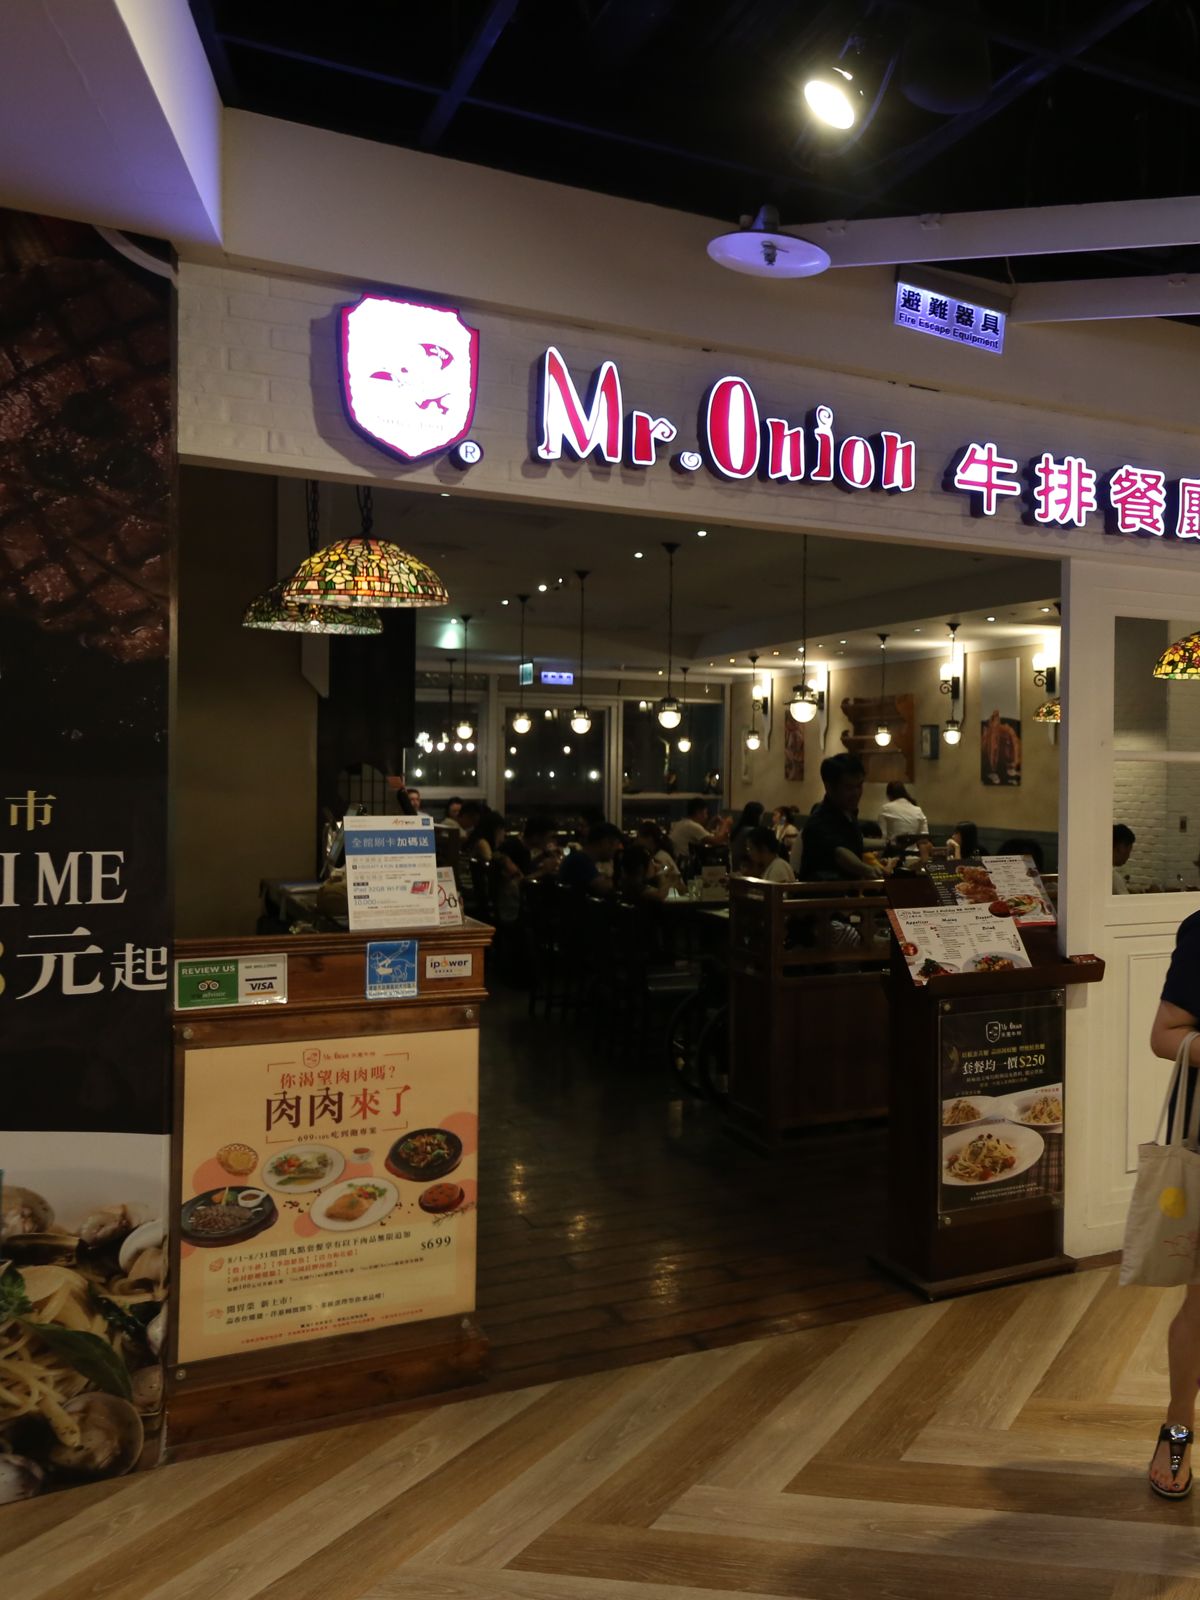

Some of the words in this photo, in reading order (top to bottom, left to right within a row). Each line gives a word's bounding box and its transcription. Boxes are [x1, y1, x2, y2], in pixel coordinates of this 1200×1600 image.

[899, 312, 916, 325] Fire
[919, 318, 951, 335] Escape
[953, 328, 999, 349] Equipment
[901, 288, 999, 336] 避難器具
[5, 790, 57, 831] 市
[0, 926, 168, 1000] 元起
[181, 965, 220, 976] REVIEW
[223, 964, 236, 973] US
[250, 981, 274, 991] VISA
[265, 1085, 411, 1132] 肉肉來了
[420, 1235, 452, 1251] $699
